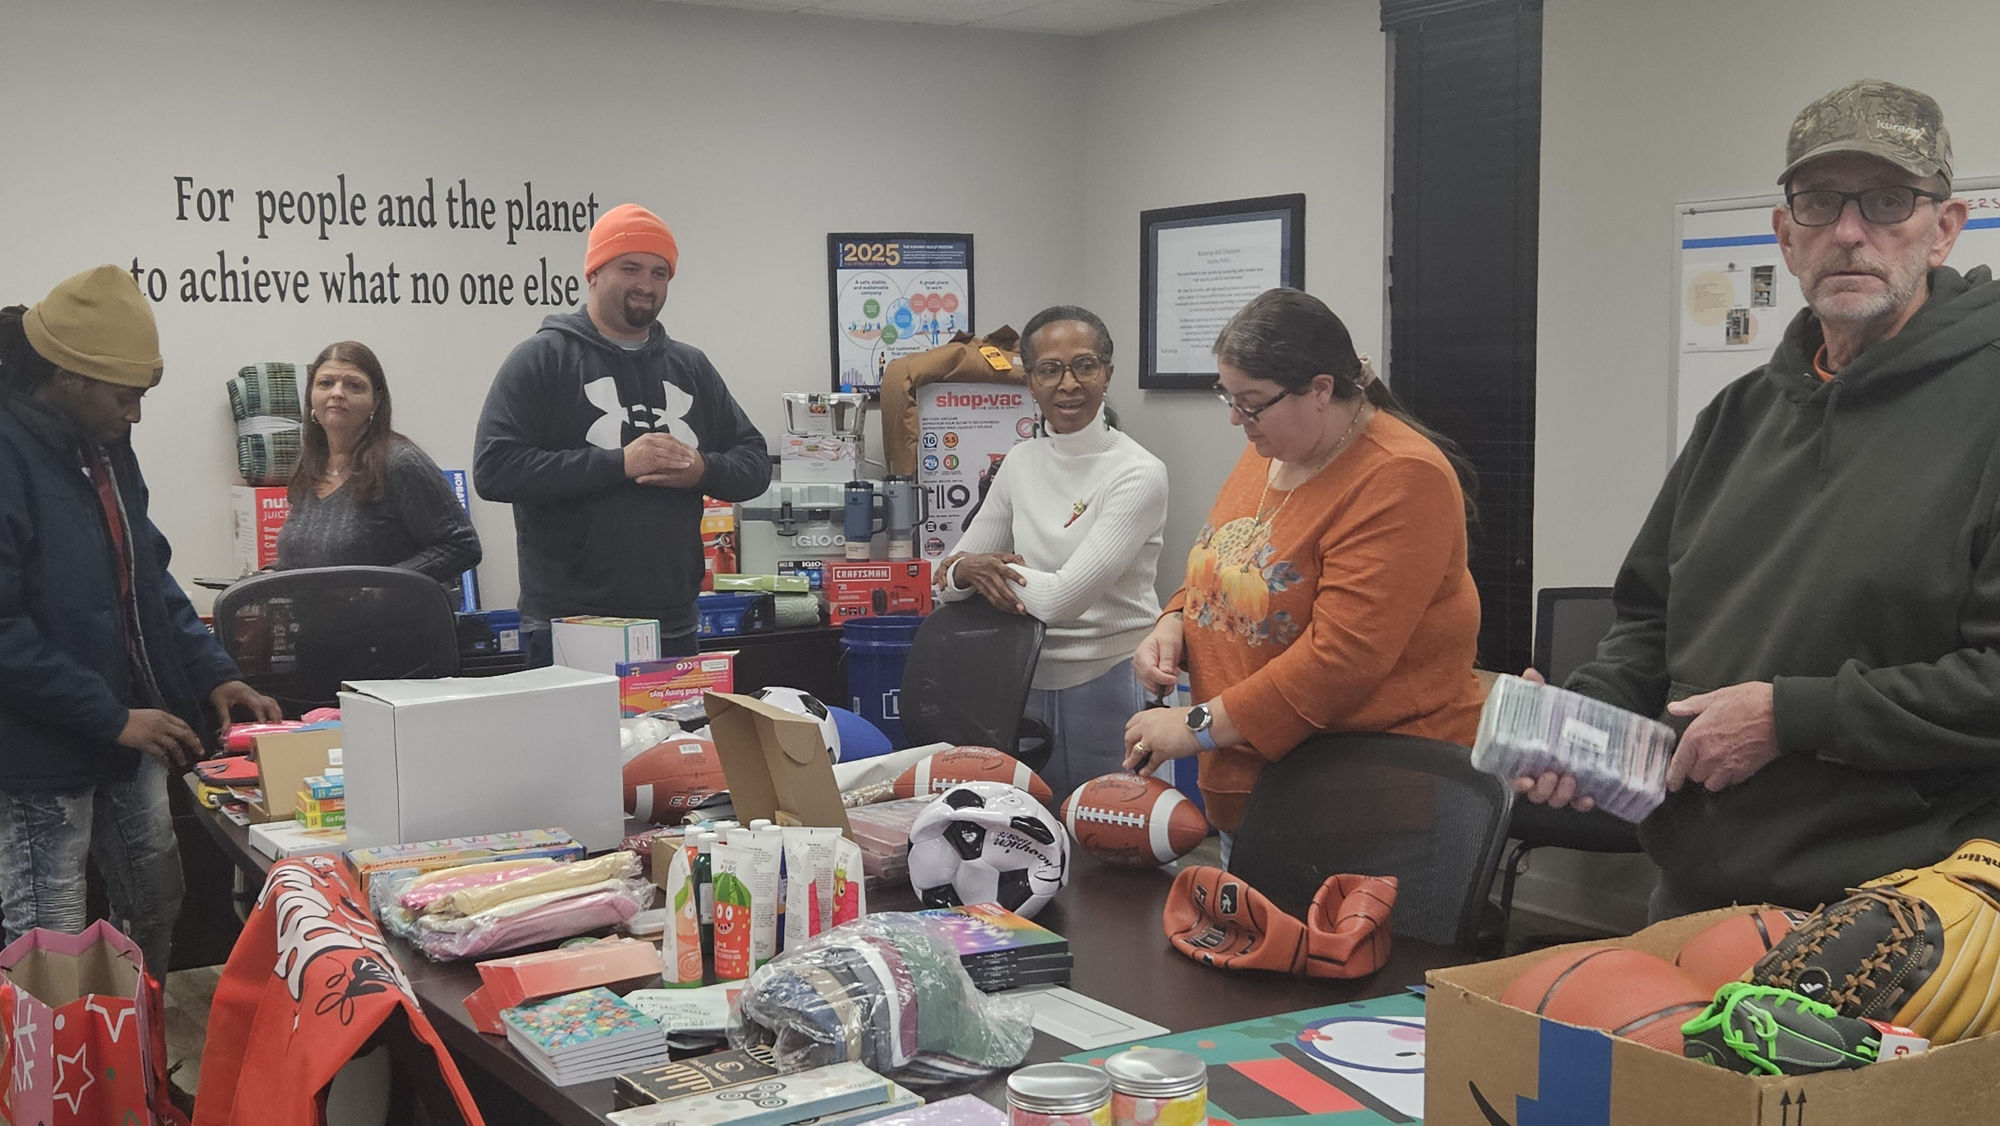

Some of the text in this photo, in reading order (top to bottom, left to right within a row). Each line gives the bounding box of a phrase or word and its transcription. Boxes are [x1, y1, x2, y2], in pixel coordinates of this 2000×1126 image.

[173, 173, 599, 243] For people and the planet
[844, 243, 900, 266] 2025
[130, 249, 580, 307] to achieve what no one else
[925, 436, 936, 444] 16
[792, 534, 846, 548] IGLOO
[836, 570, 888, 579] CRAFTSMAN
